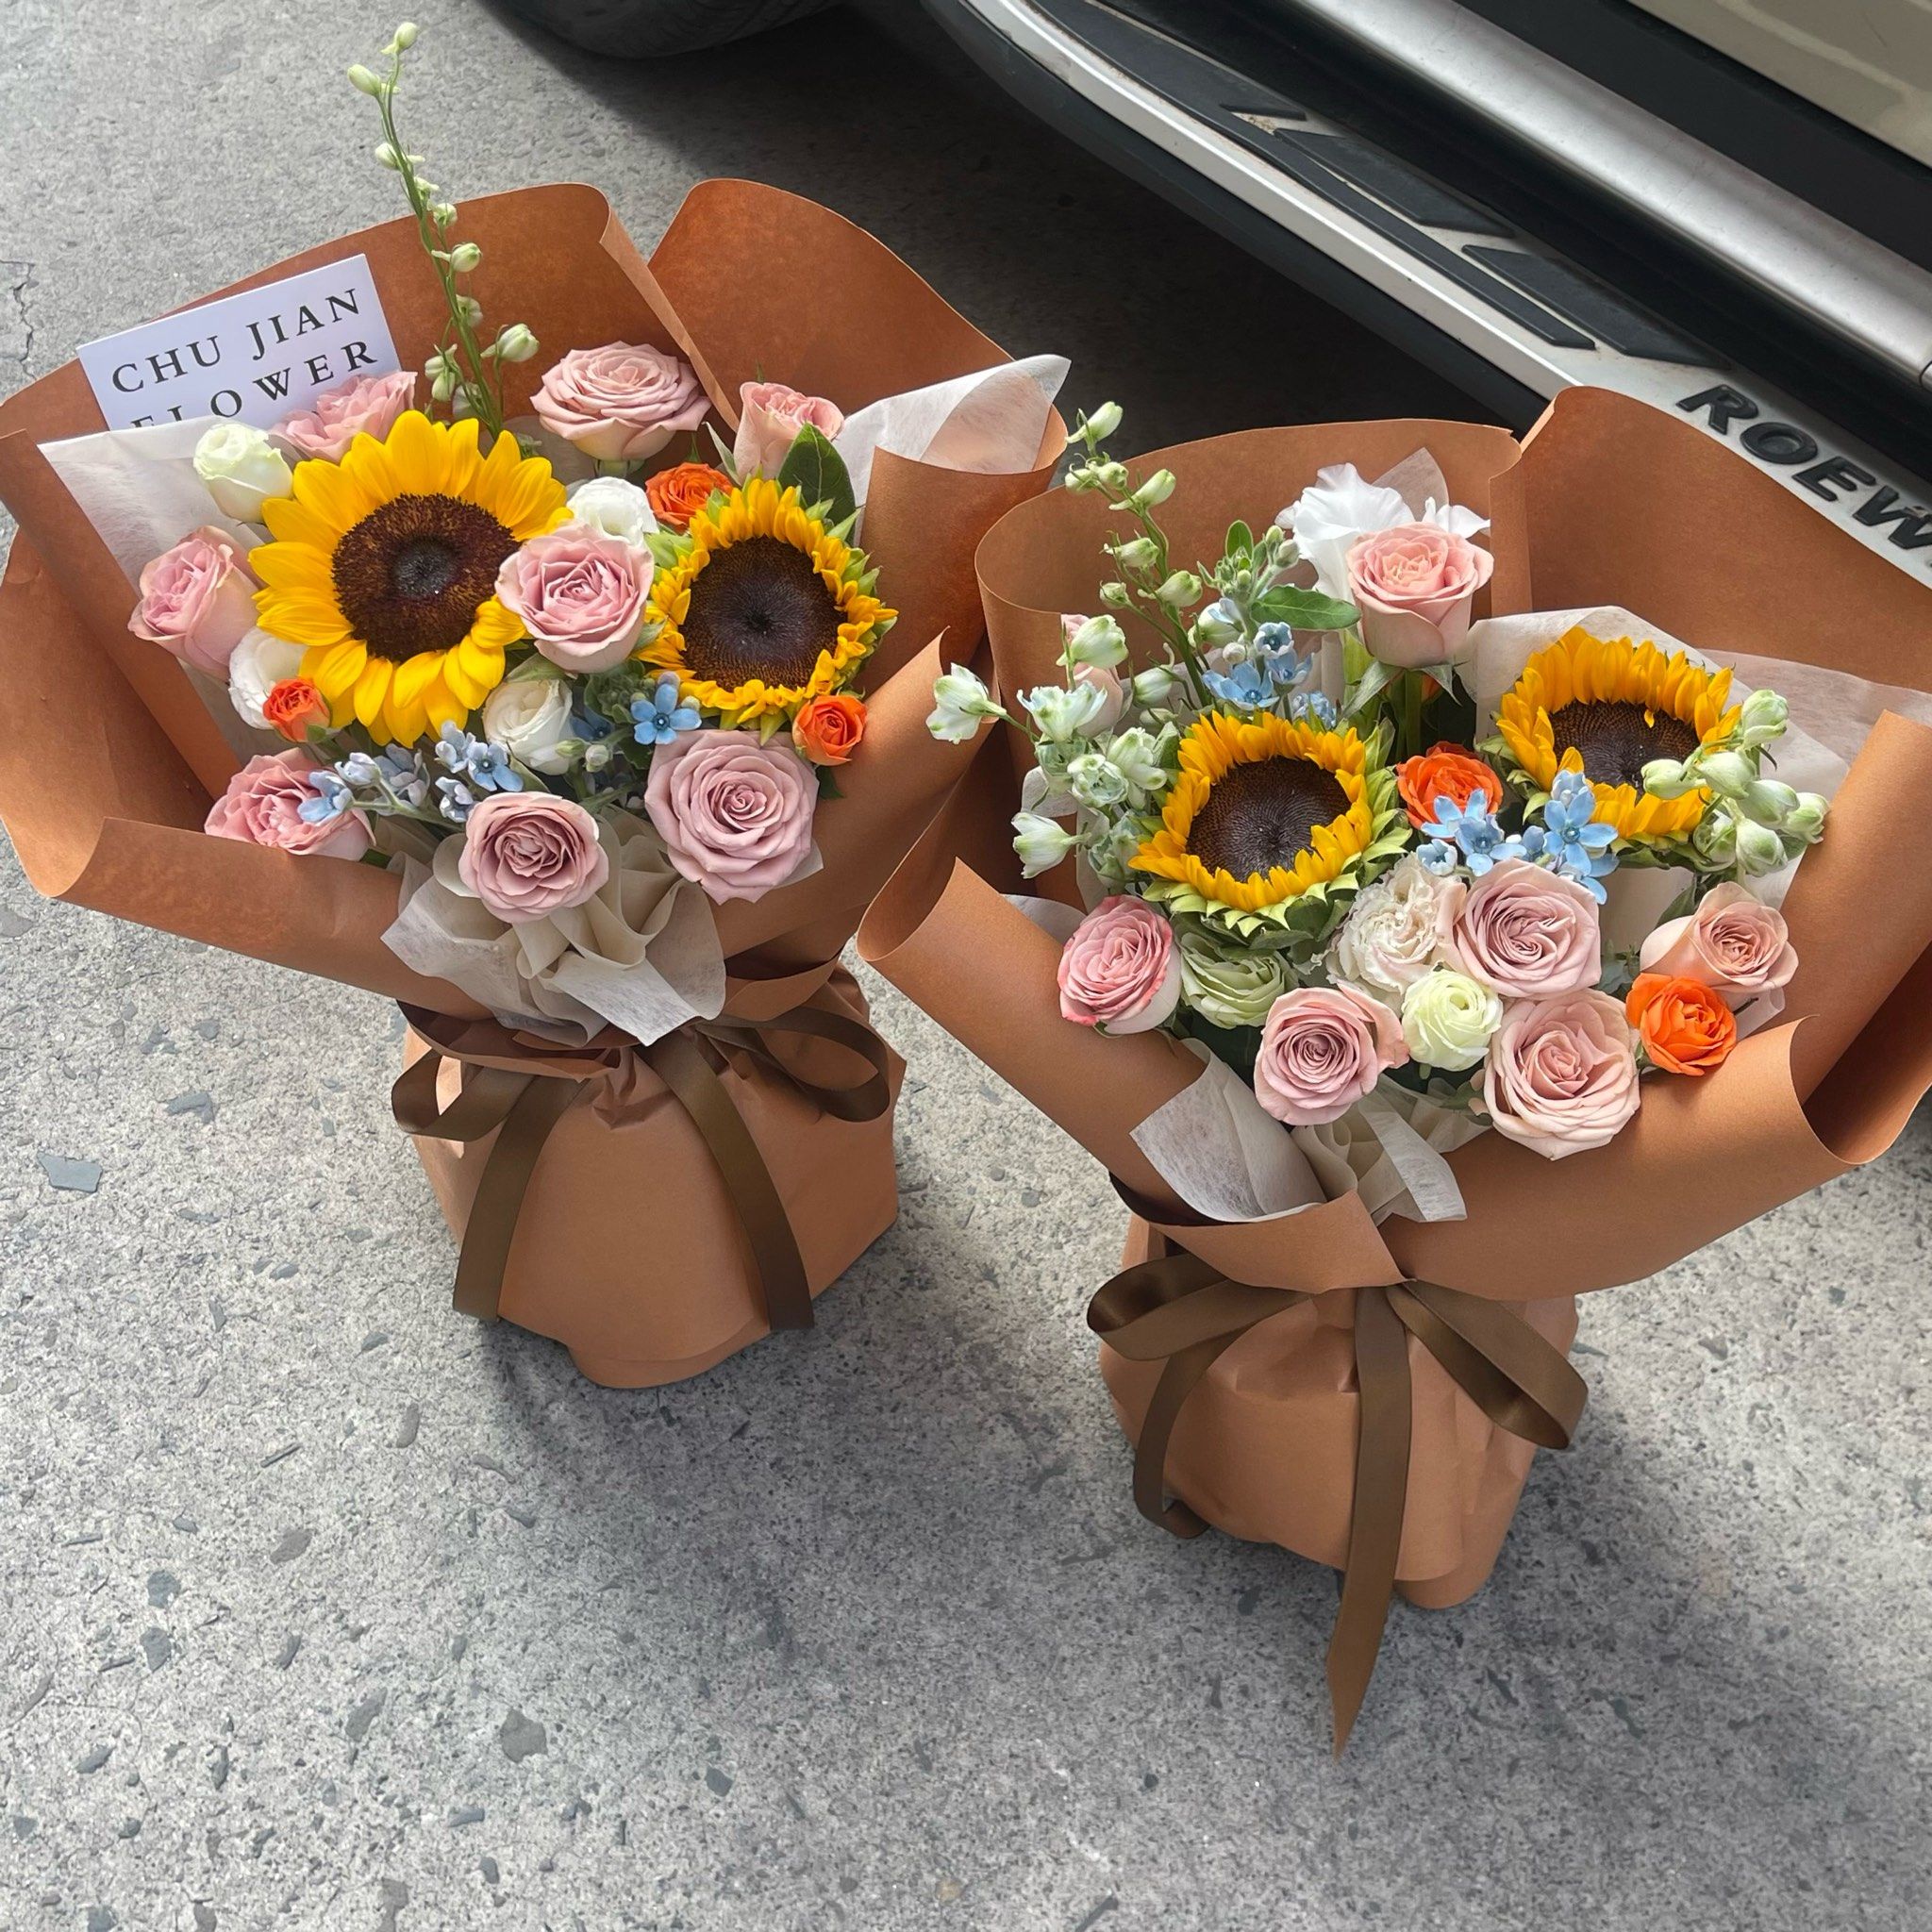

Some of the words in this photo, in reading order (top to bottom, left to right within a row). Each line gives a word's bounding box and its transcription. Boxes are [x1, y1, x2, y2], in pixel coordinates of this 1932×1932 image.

[111, 335, 222, 393] CHU
[245, 288, 360, 360] JIAN
[1674, 383, 1932, 568] ROEW
